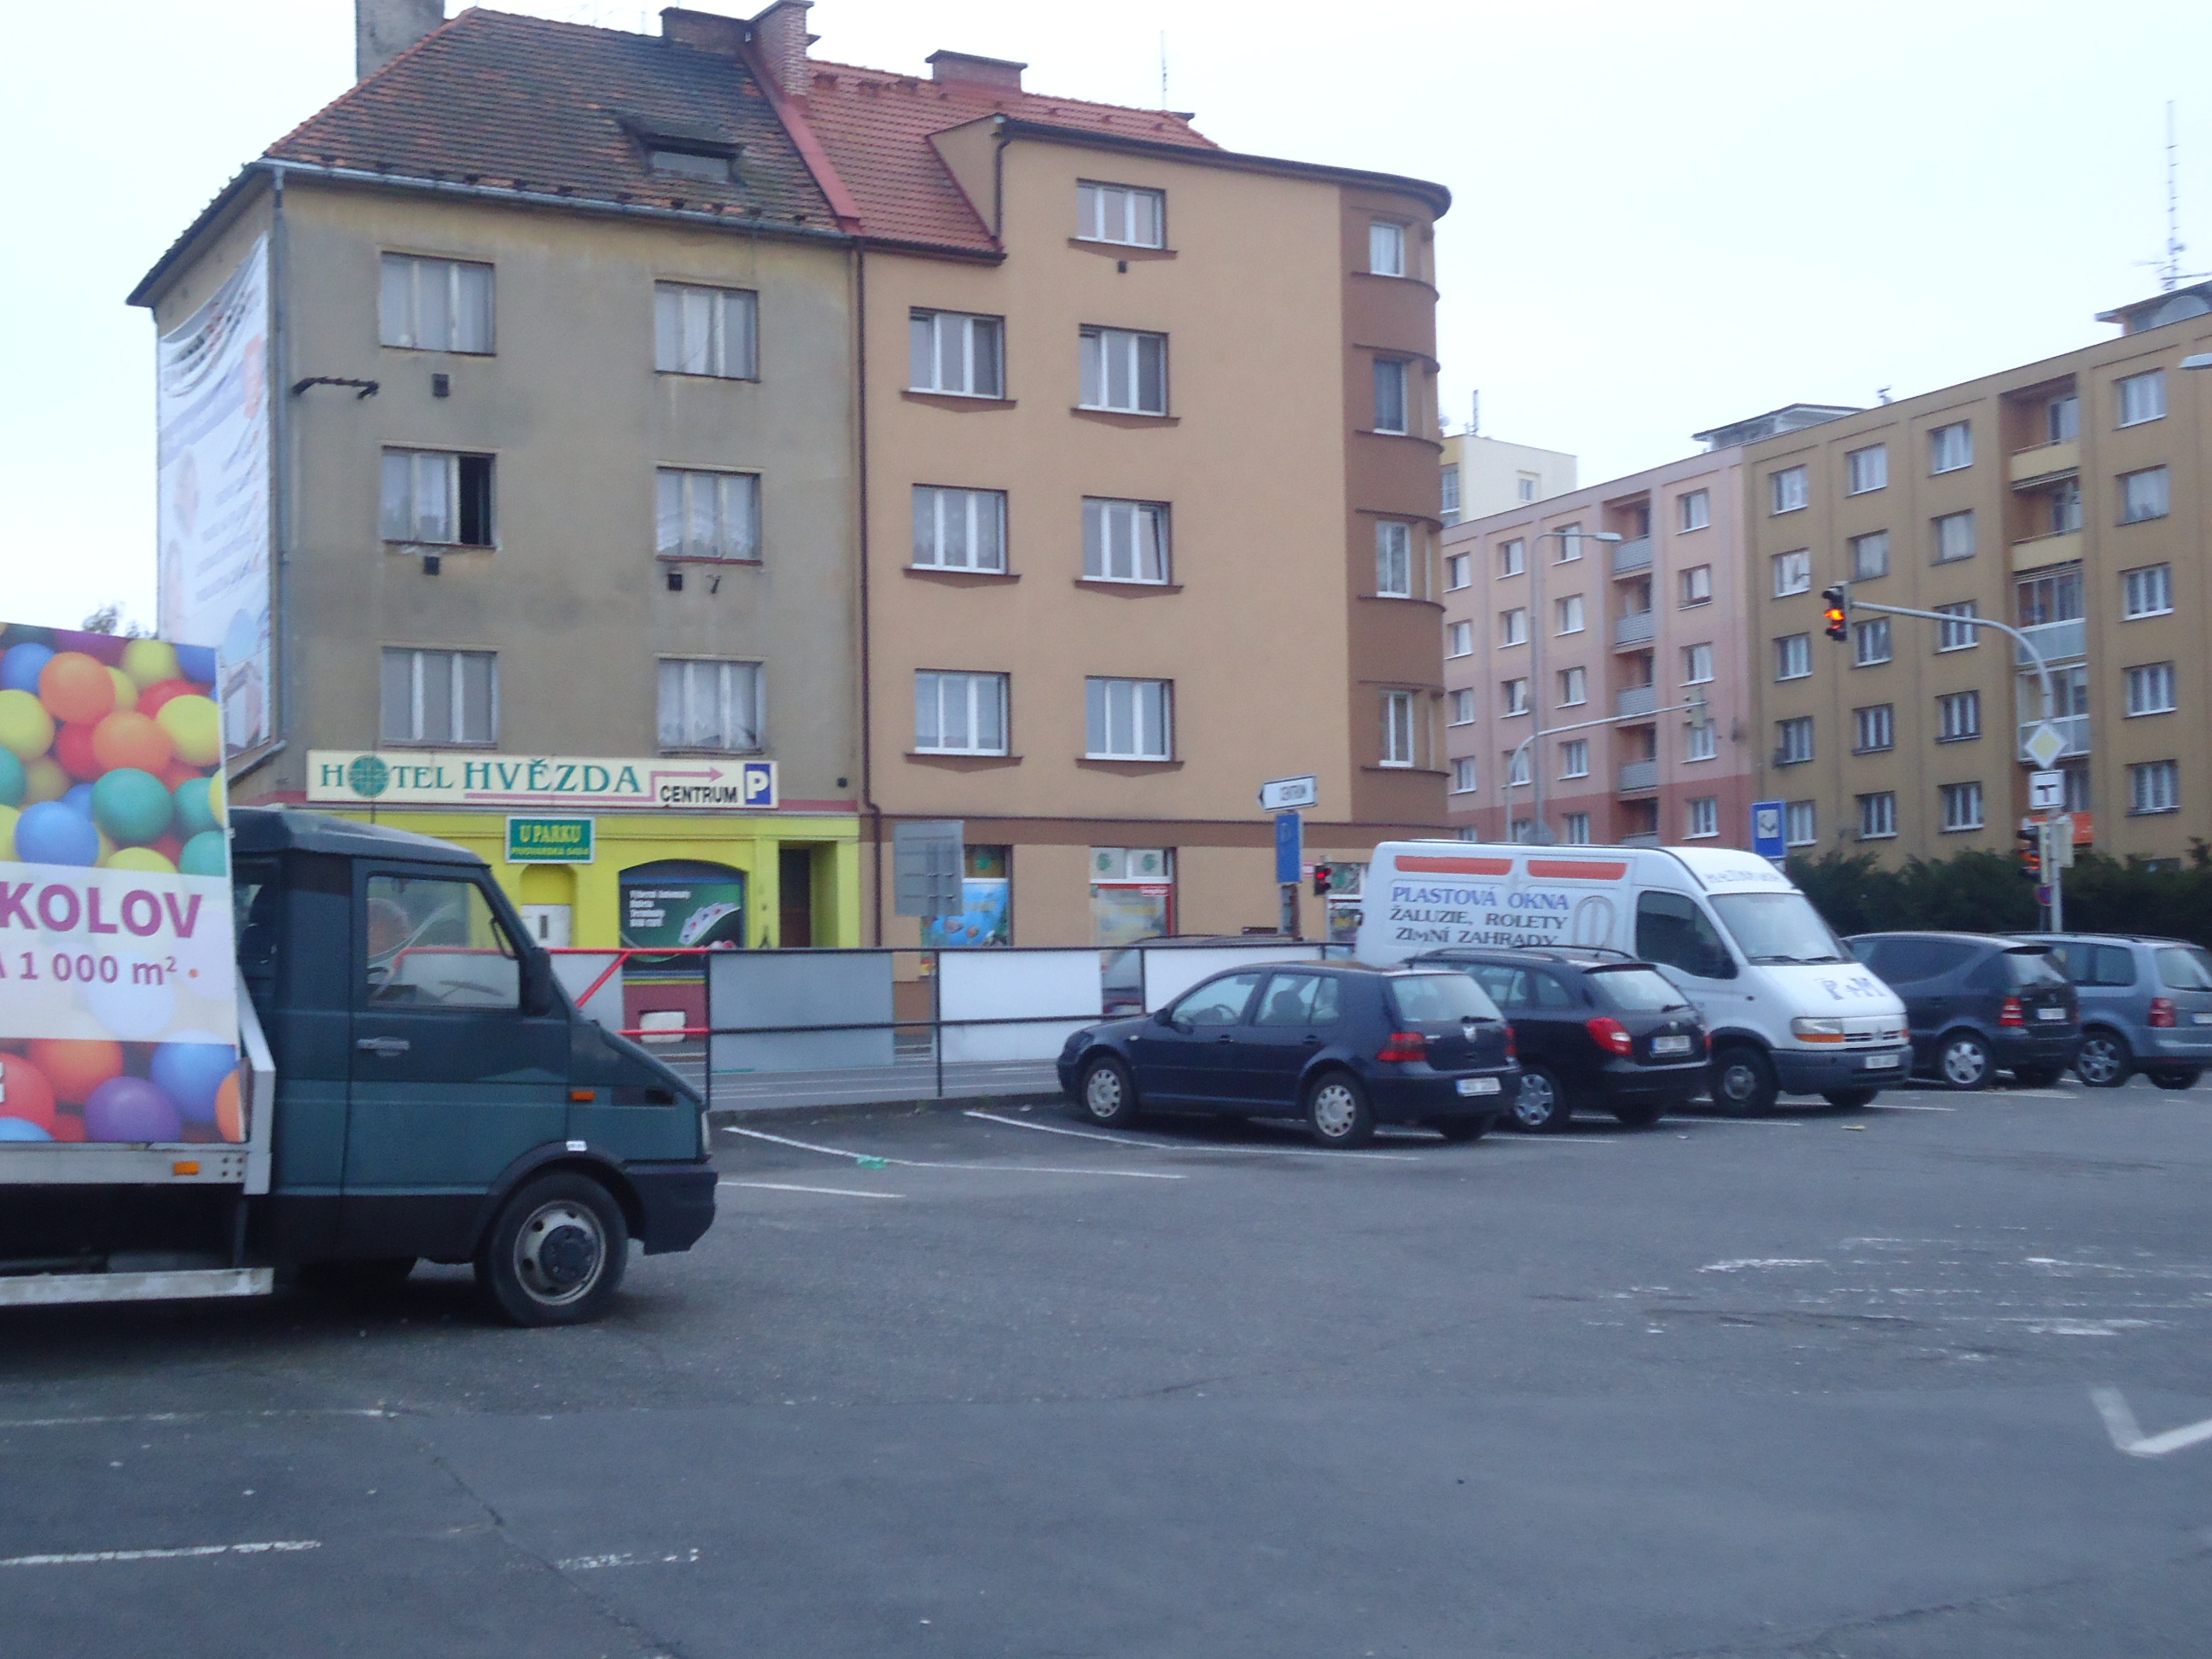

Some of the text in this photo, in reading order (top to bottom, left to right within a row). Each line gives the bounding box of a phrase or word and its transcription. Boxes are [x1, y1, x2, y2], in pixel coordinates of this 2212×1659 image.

[321, 755, 642, 796] HOTEL HVĚZDA
[746, 771, 769, 800] P
[660, 785, 738, 804] CENTRUM
[533, 824, 582, 843] PARKU
[0, 881, 203, 939] KOLOV
[1391, 886, 1569, 911] PLASTOVÁ OKNA
[1389, 905, 1569, 929] ŽALUZIE, ROLETY
[1395, 927, 1558, 946] ZIMNÍ ZAHRADY
[20, 952, 38, 980] 1
[52, 952, 119, 983] 000
